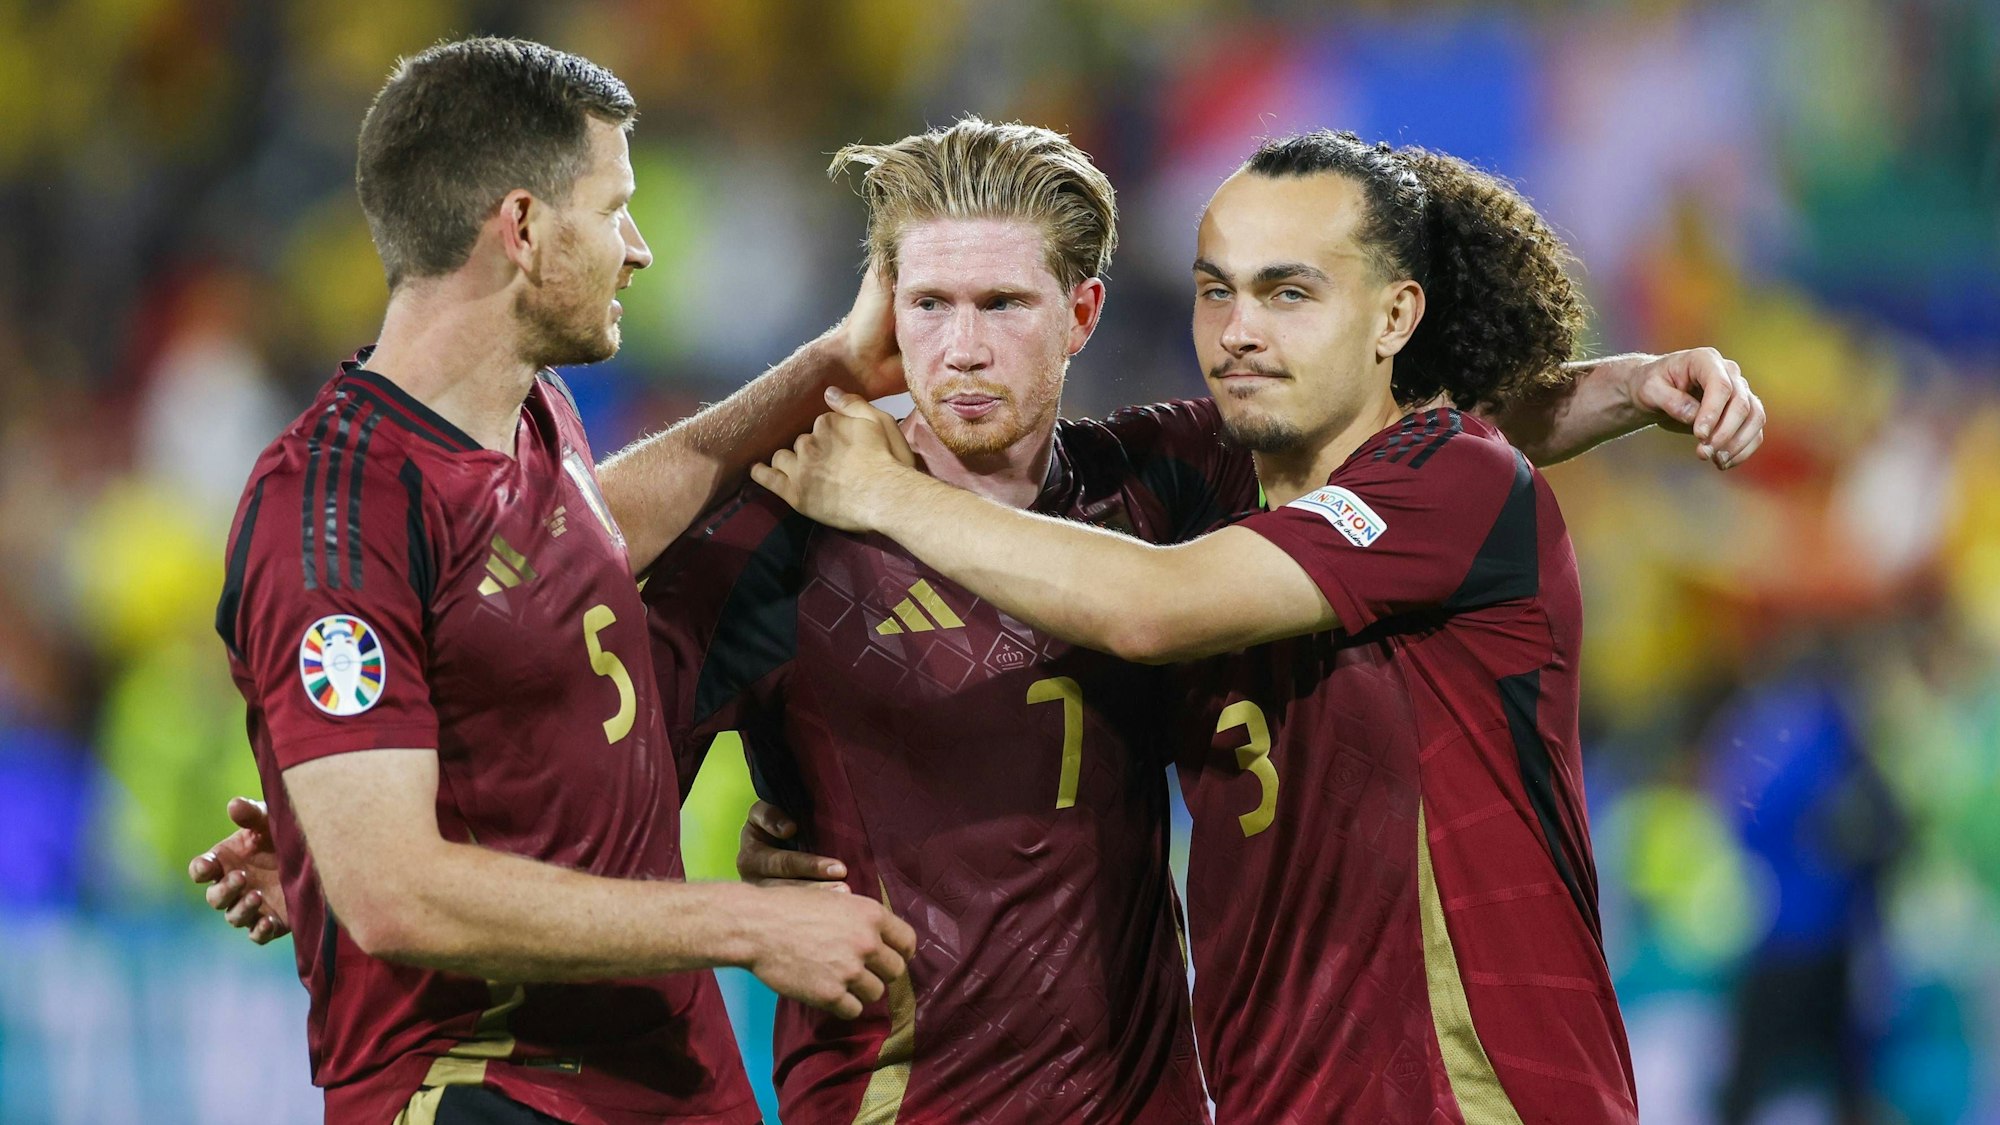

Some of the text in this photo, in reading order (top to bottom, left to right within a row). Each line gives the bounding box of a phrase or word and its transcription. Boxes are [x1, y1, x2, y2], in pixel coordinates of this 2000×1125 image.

[1333, 519, 1344, 528] for
[583, 604, 637, 745] 5
[1026, 675, 1083, 810] 7
[1216, 700, 1280, 838] 3
